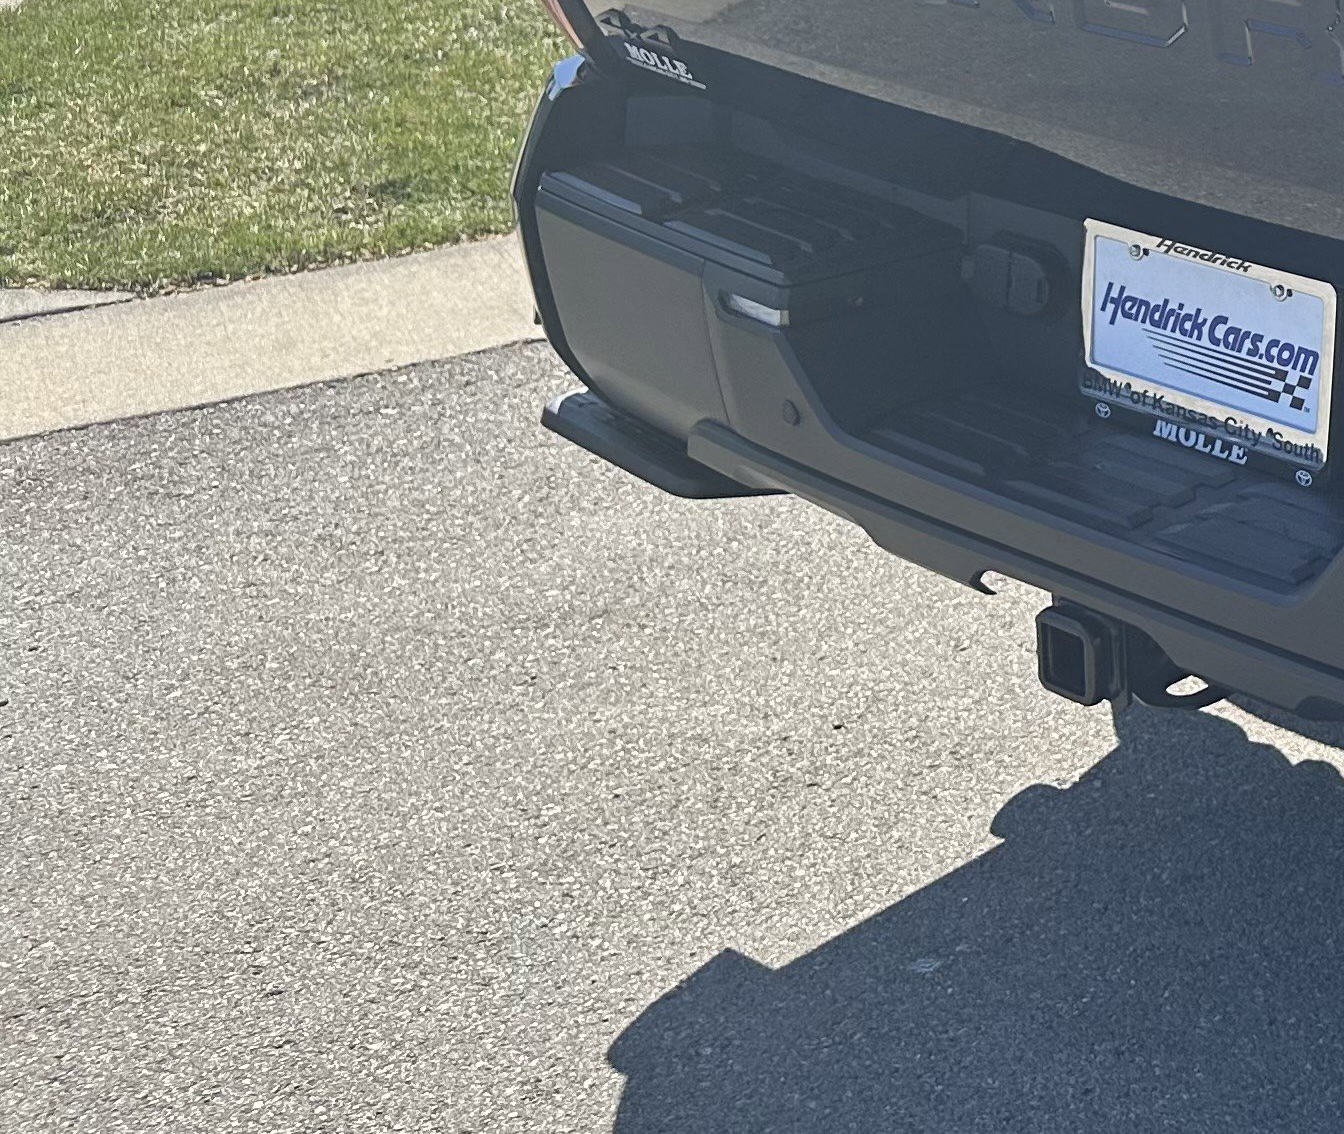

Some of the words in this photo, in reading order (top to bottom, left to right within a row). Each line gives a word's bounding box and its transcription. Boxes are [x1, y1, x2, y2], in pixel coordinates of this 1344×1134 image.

[624, 42, 692, 79] MOLLE
[1156, 238, 1251, 273] Hendrick
[1082, 372, 1123, 398] BMW
[1130, 389, 1149, 405] of
[1153, 392, 1218, 429] Kansas
[1224, 416, 1262, 447] City
[1272, 431, 1324, 464] South
[1153, 419, 1248, 465] MOLLE
